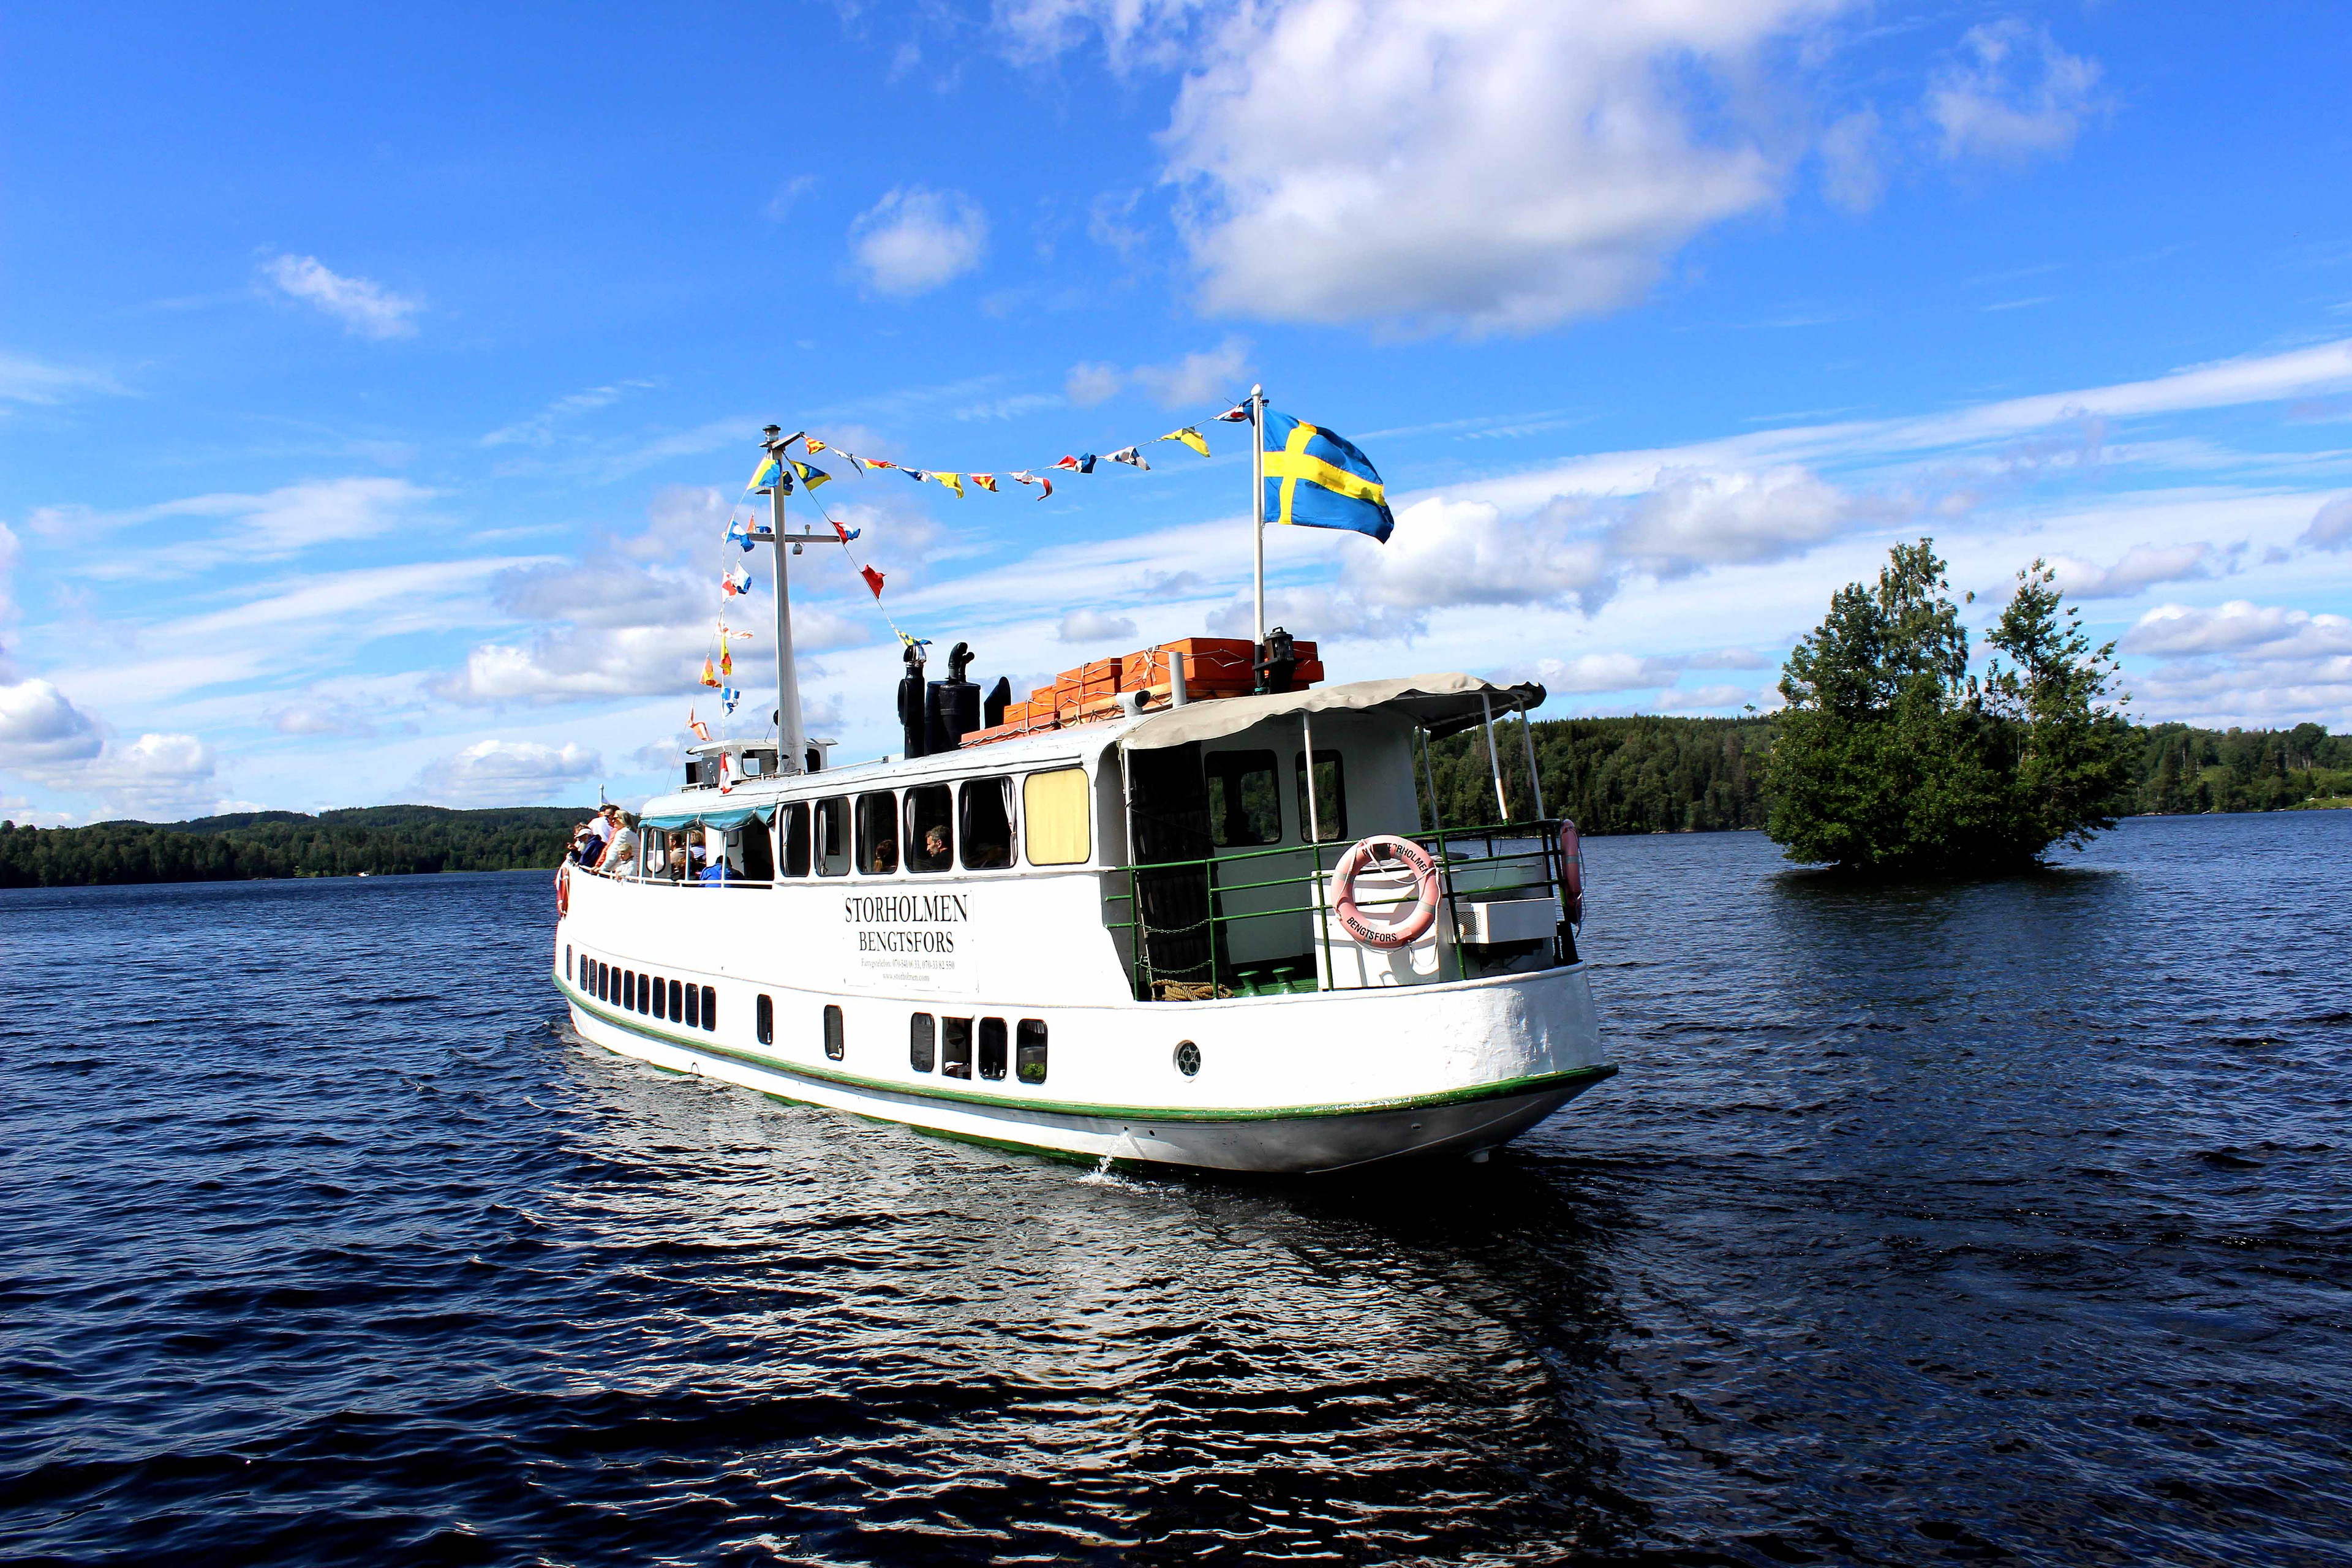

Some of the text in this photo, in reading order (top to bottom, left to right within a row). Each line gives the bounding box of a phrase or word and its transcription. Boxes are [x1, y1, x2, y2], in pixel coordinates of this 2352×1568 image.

[1387, 842, 1429, 875] TORHOLMEN
[845, 894, 968, 922] STORHOLMEN
[859, 931, 954, 953] BENGTSFORS
[1346, 916, 1398, 943] BENGTSFORS
[938, 960, 944, 970] 82
